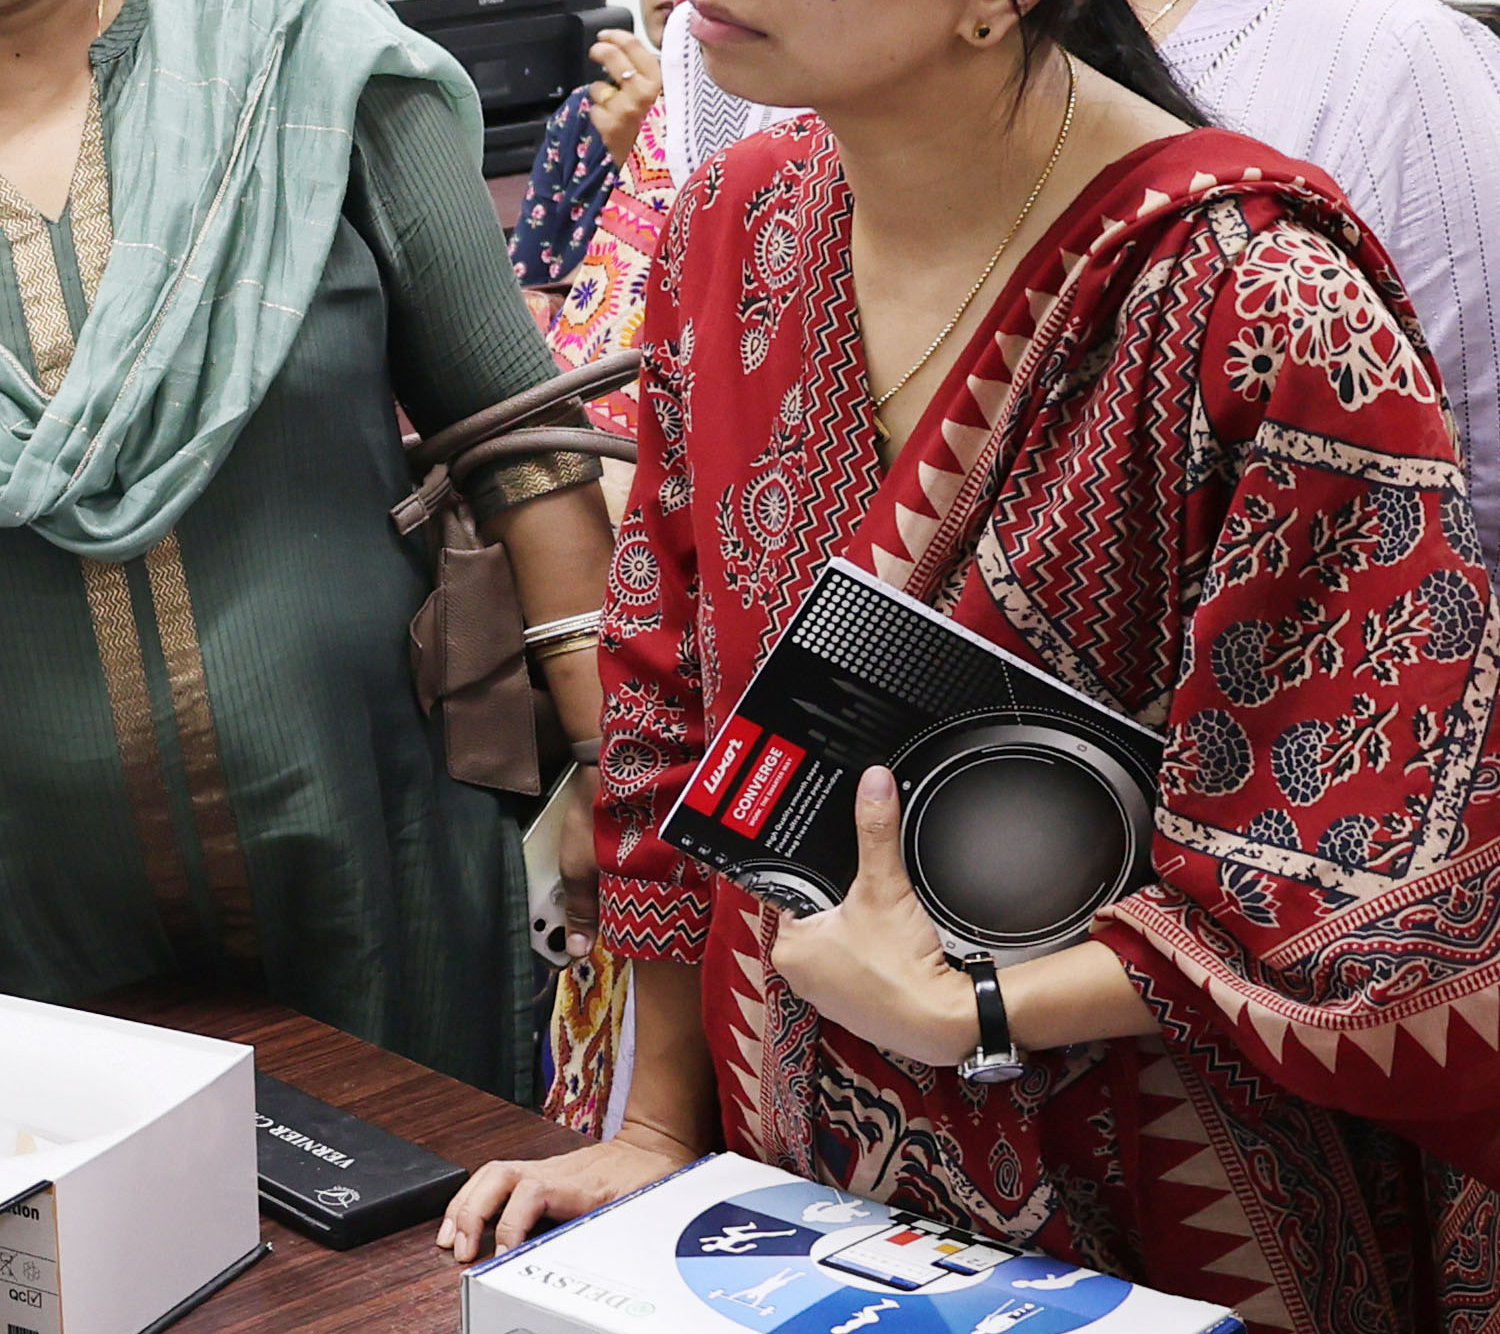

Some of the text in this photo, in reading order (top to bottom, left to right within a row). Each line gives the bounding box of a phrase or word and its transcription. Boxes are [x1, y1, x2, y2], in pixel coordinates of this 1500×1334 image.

[732, 745, 784, 820] CONVERGE
[764, 760, 821, 848] High Quality smooth paper
[774, 774, 825, 853] Finest ultra white paper
[784, 840, 800, 858] Snag
[794, 825, 808, 840] free
[814, 794, 827, 810] wire
[821, 768, 844, 795] binding
[268, 1124, 355, 1169] VERNIER
[8, 1288, 28, 1303] QC
[517, 1264, 632, 1309] DELSYS
